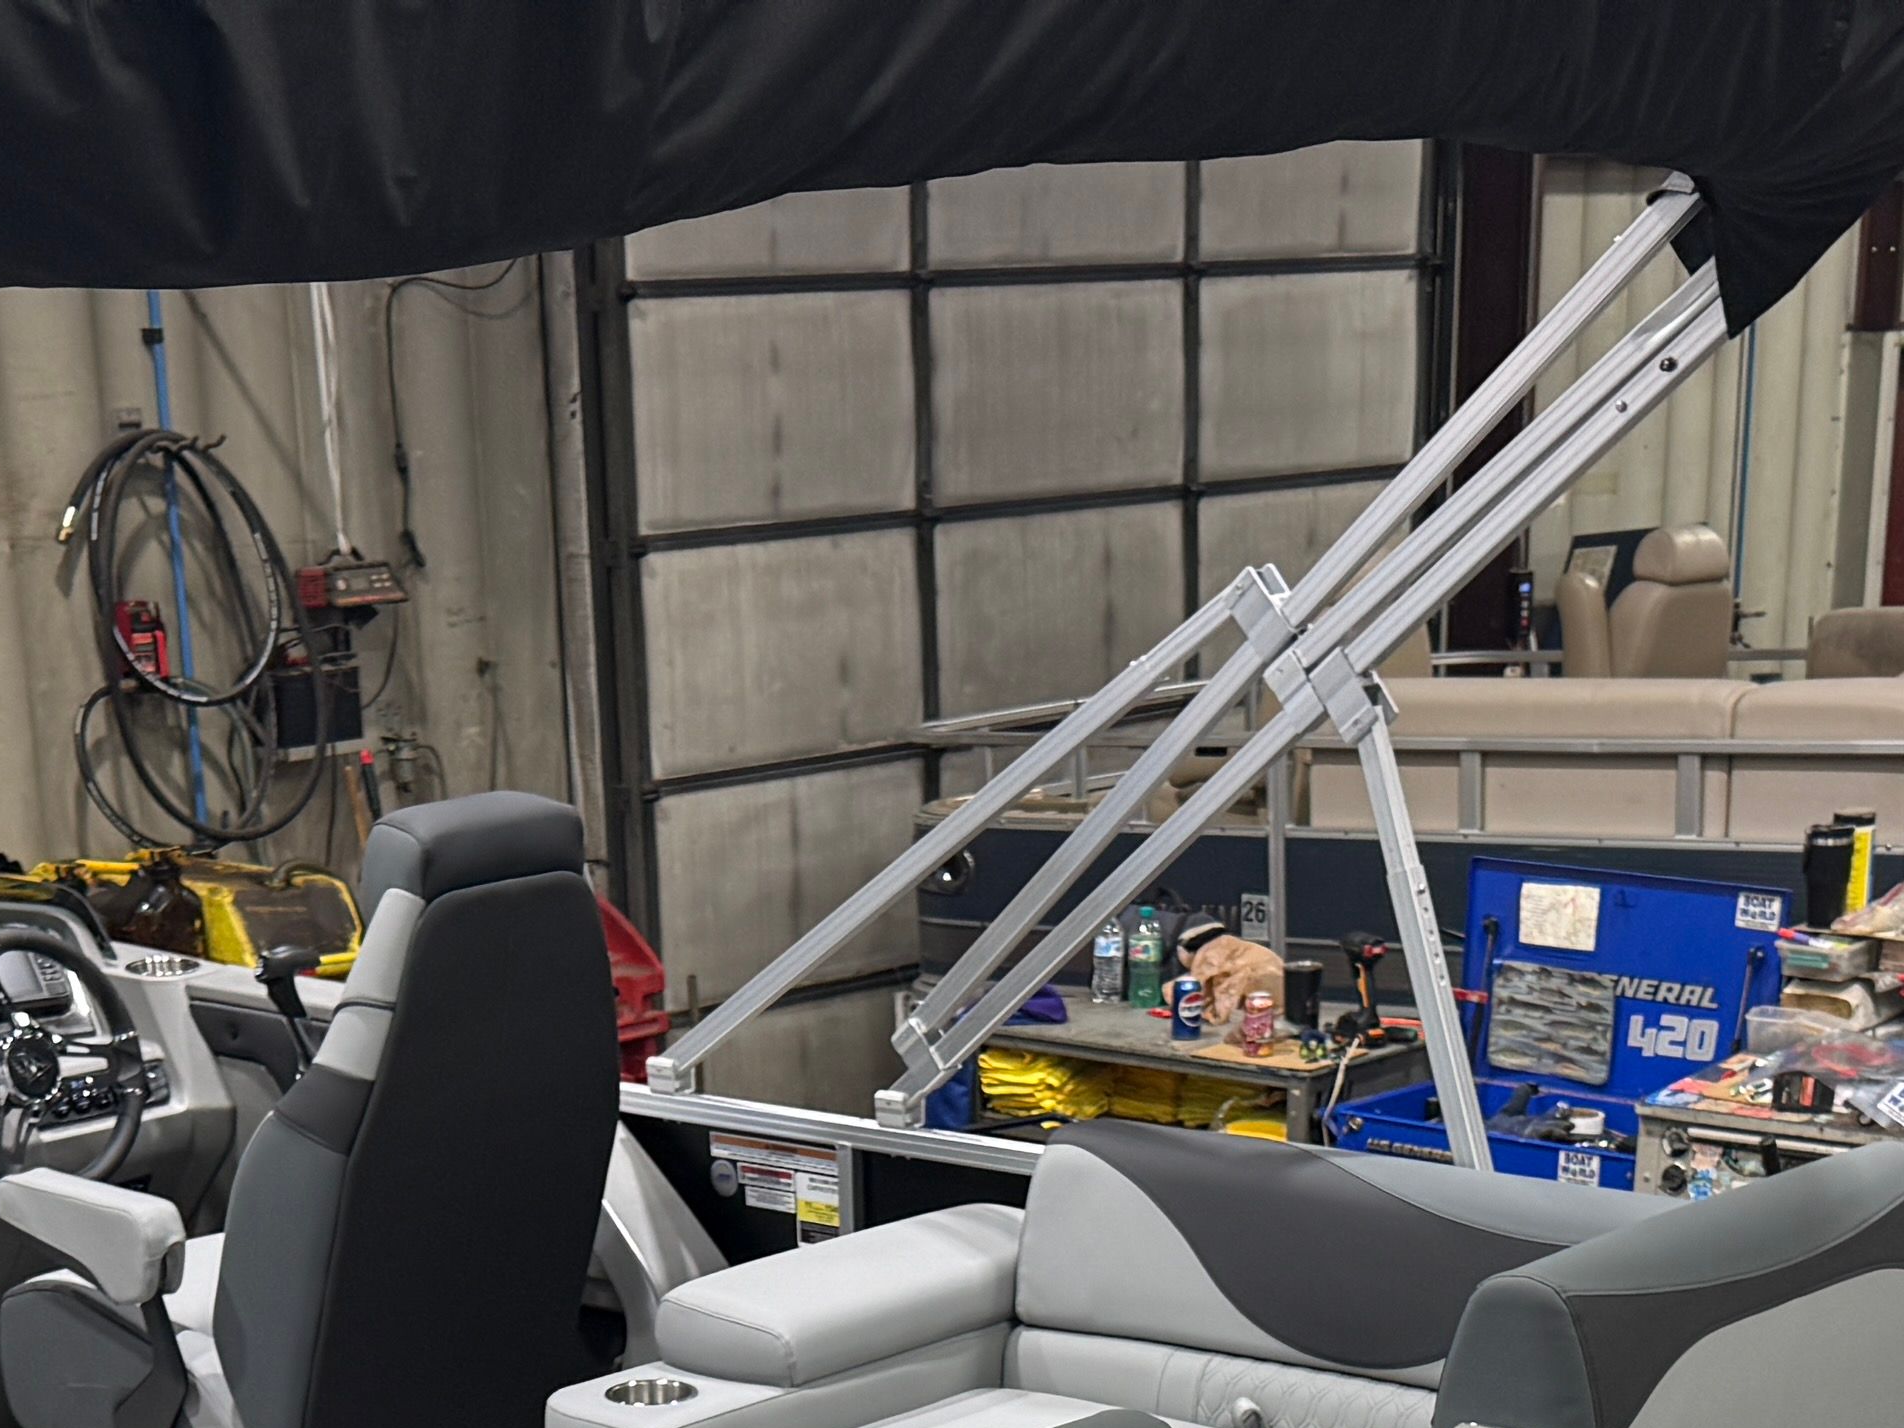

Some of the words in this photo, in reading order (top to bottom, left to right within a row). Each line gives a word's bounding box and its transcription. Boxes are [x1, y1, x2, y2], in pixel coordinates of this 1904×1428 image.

[1242, 900, 1266, 923] 26
[1601, 973, 1718, 1009] NERAL
[1627, 1014, 1719, 1062] 420
